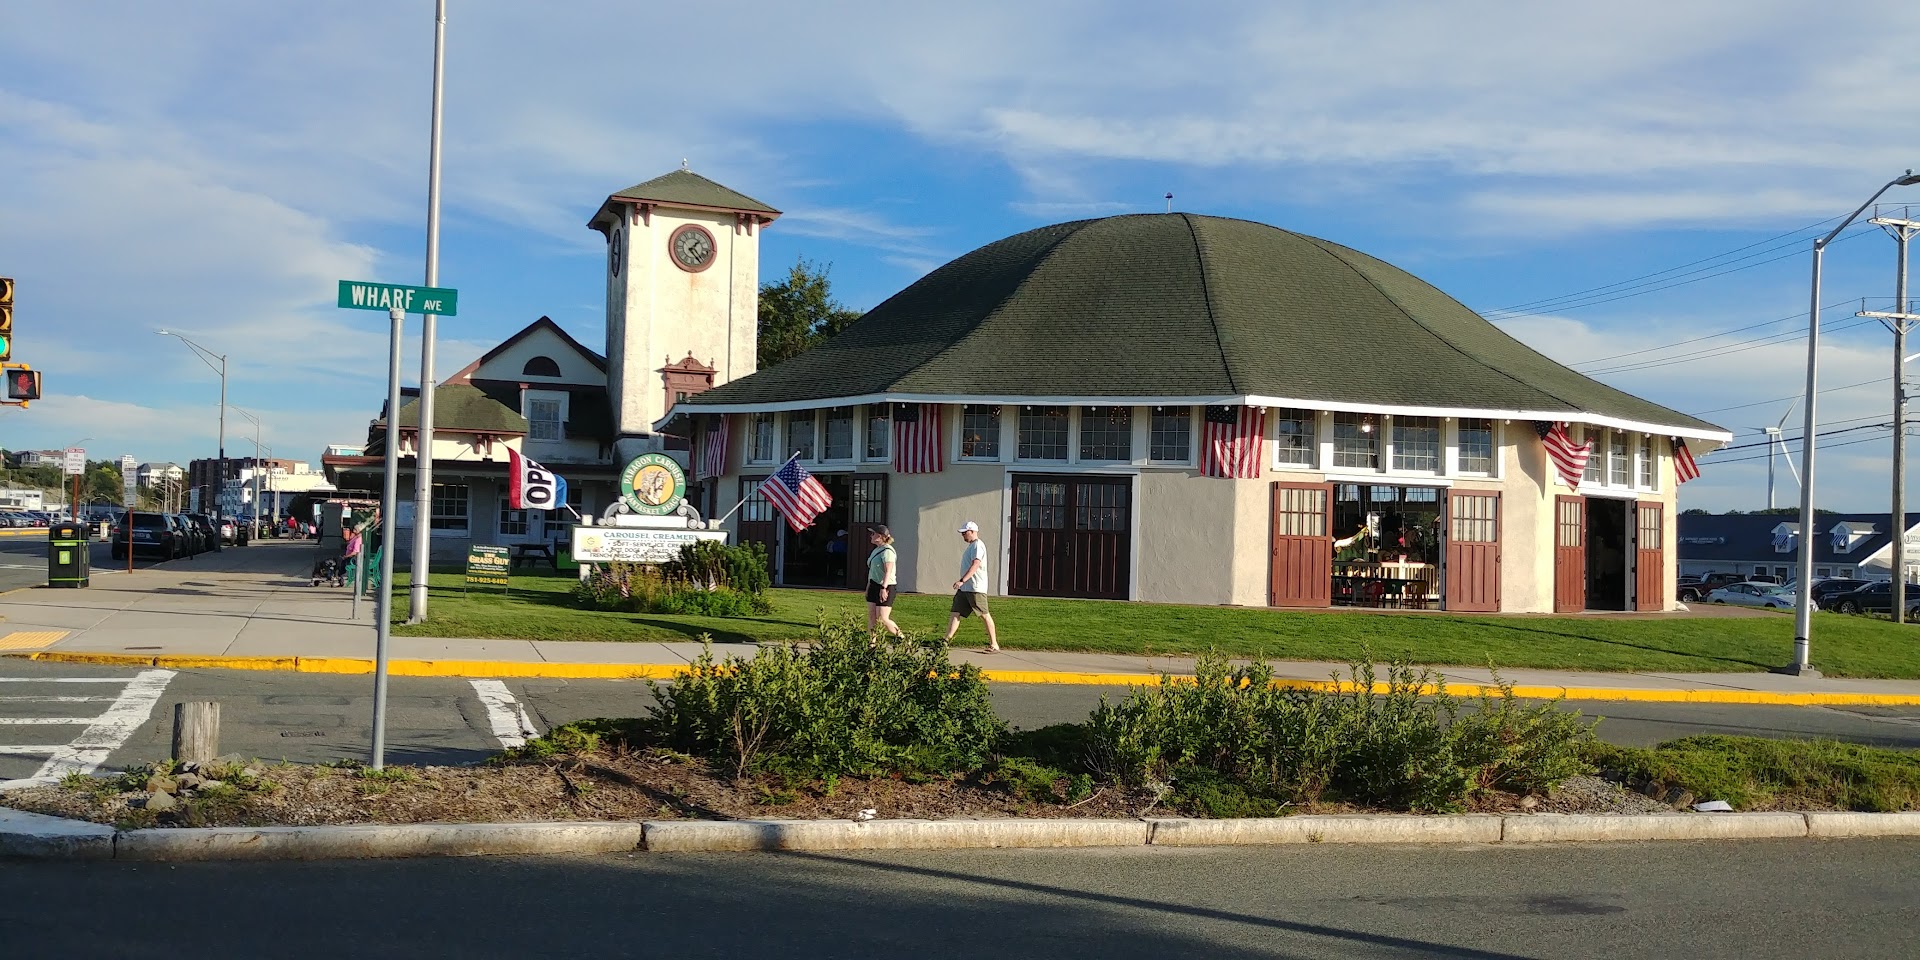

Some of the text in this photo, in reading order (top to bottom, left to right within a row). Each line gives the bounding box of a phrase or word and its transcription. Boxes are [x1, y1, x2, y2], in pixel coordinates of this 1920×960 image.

[351, 284, 442, 312] WHARF AVE
[623, 455, 684, 487] PARAGON CAROUSEL
[625, 492, 681, 515] NANTASKET BEACH
[603, 531, 650, 539] CAROUSEL
[652, 533, 699, 541] CREAMERY
[494, 556, 510, 566] GUY
